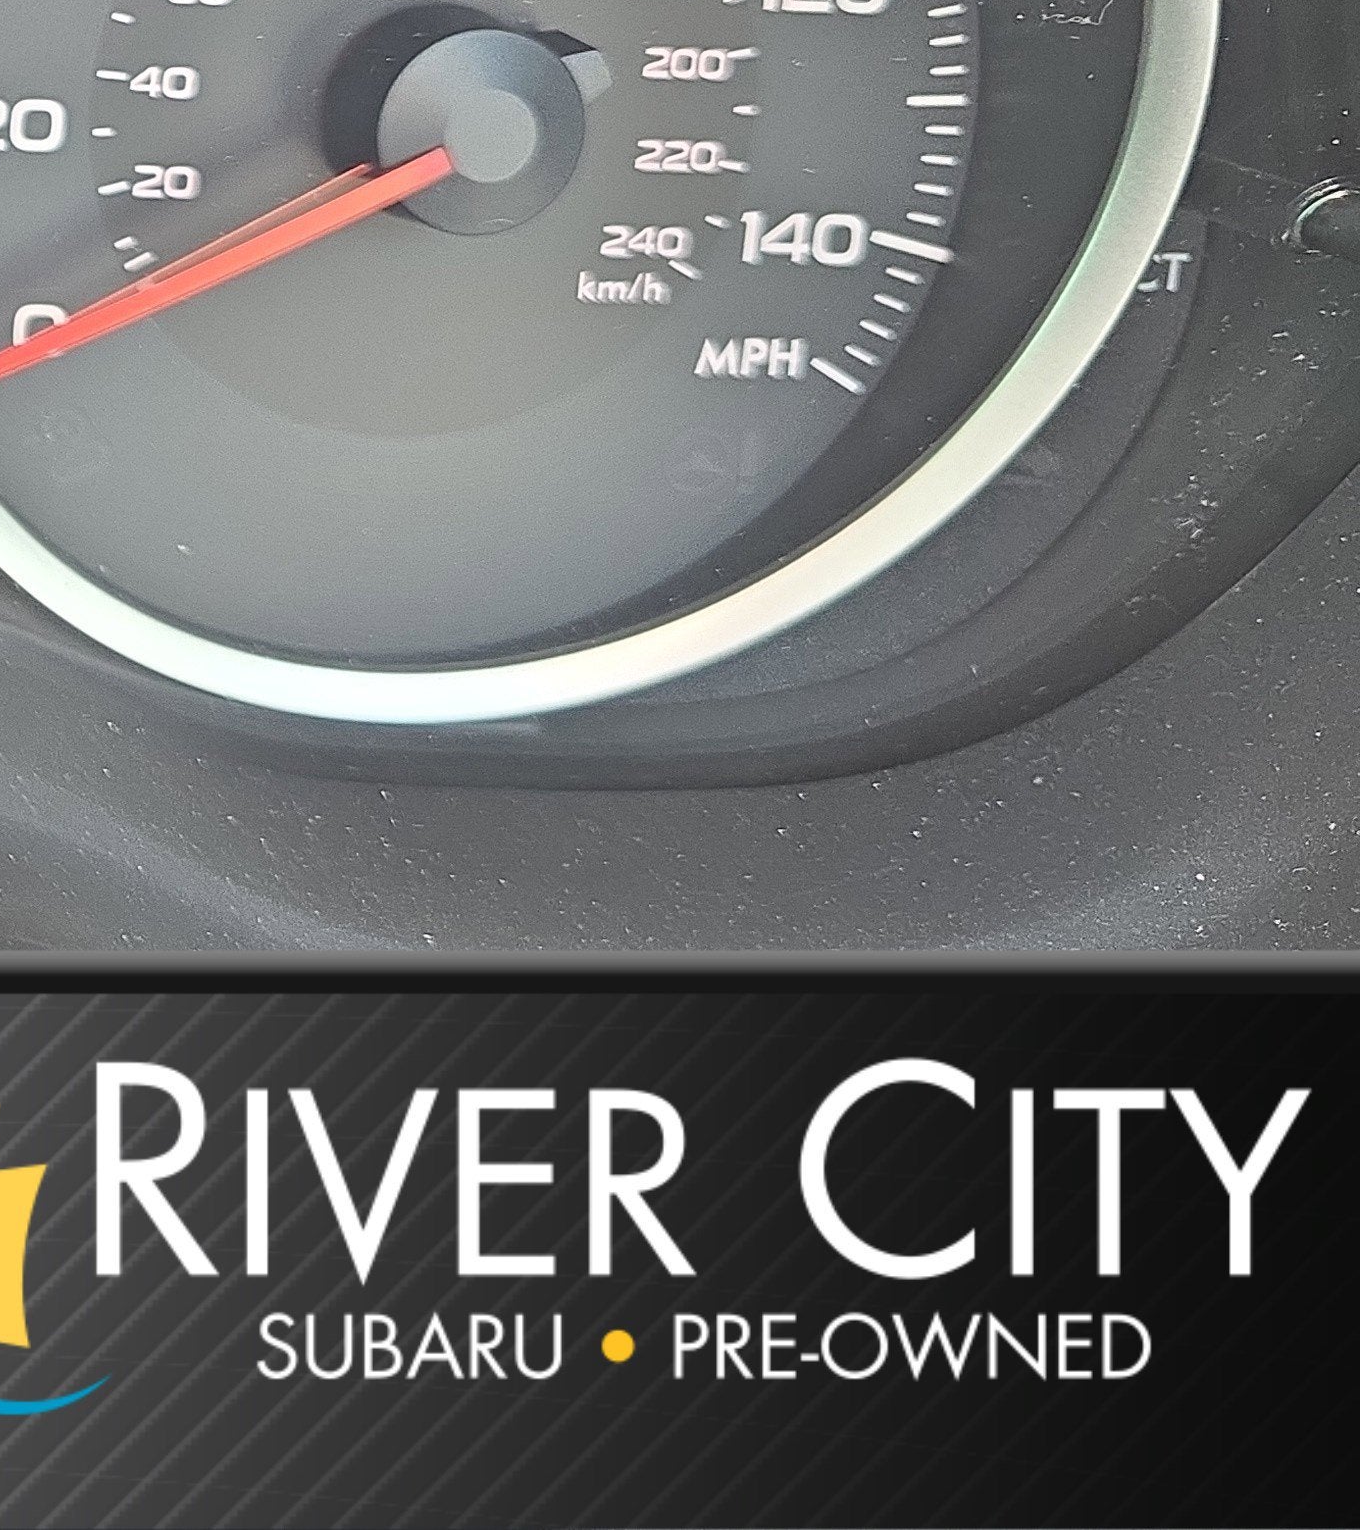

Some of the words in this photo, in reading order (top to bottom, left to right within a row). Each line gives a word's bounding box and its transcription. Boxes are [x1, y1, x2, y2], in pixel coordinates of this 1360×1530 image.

[642, 48, 731, 81] 200
[130, 66, 200, 100] 40
[634, 139, 723, 174] 220
[131, 165, 201, 200] 20
[599, 225, 694, 260] 240
[739, 210, 872, 267] 140
[577, 272, 671, 305] km/h
[694, 337, 808, 379] MPH
